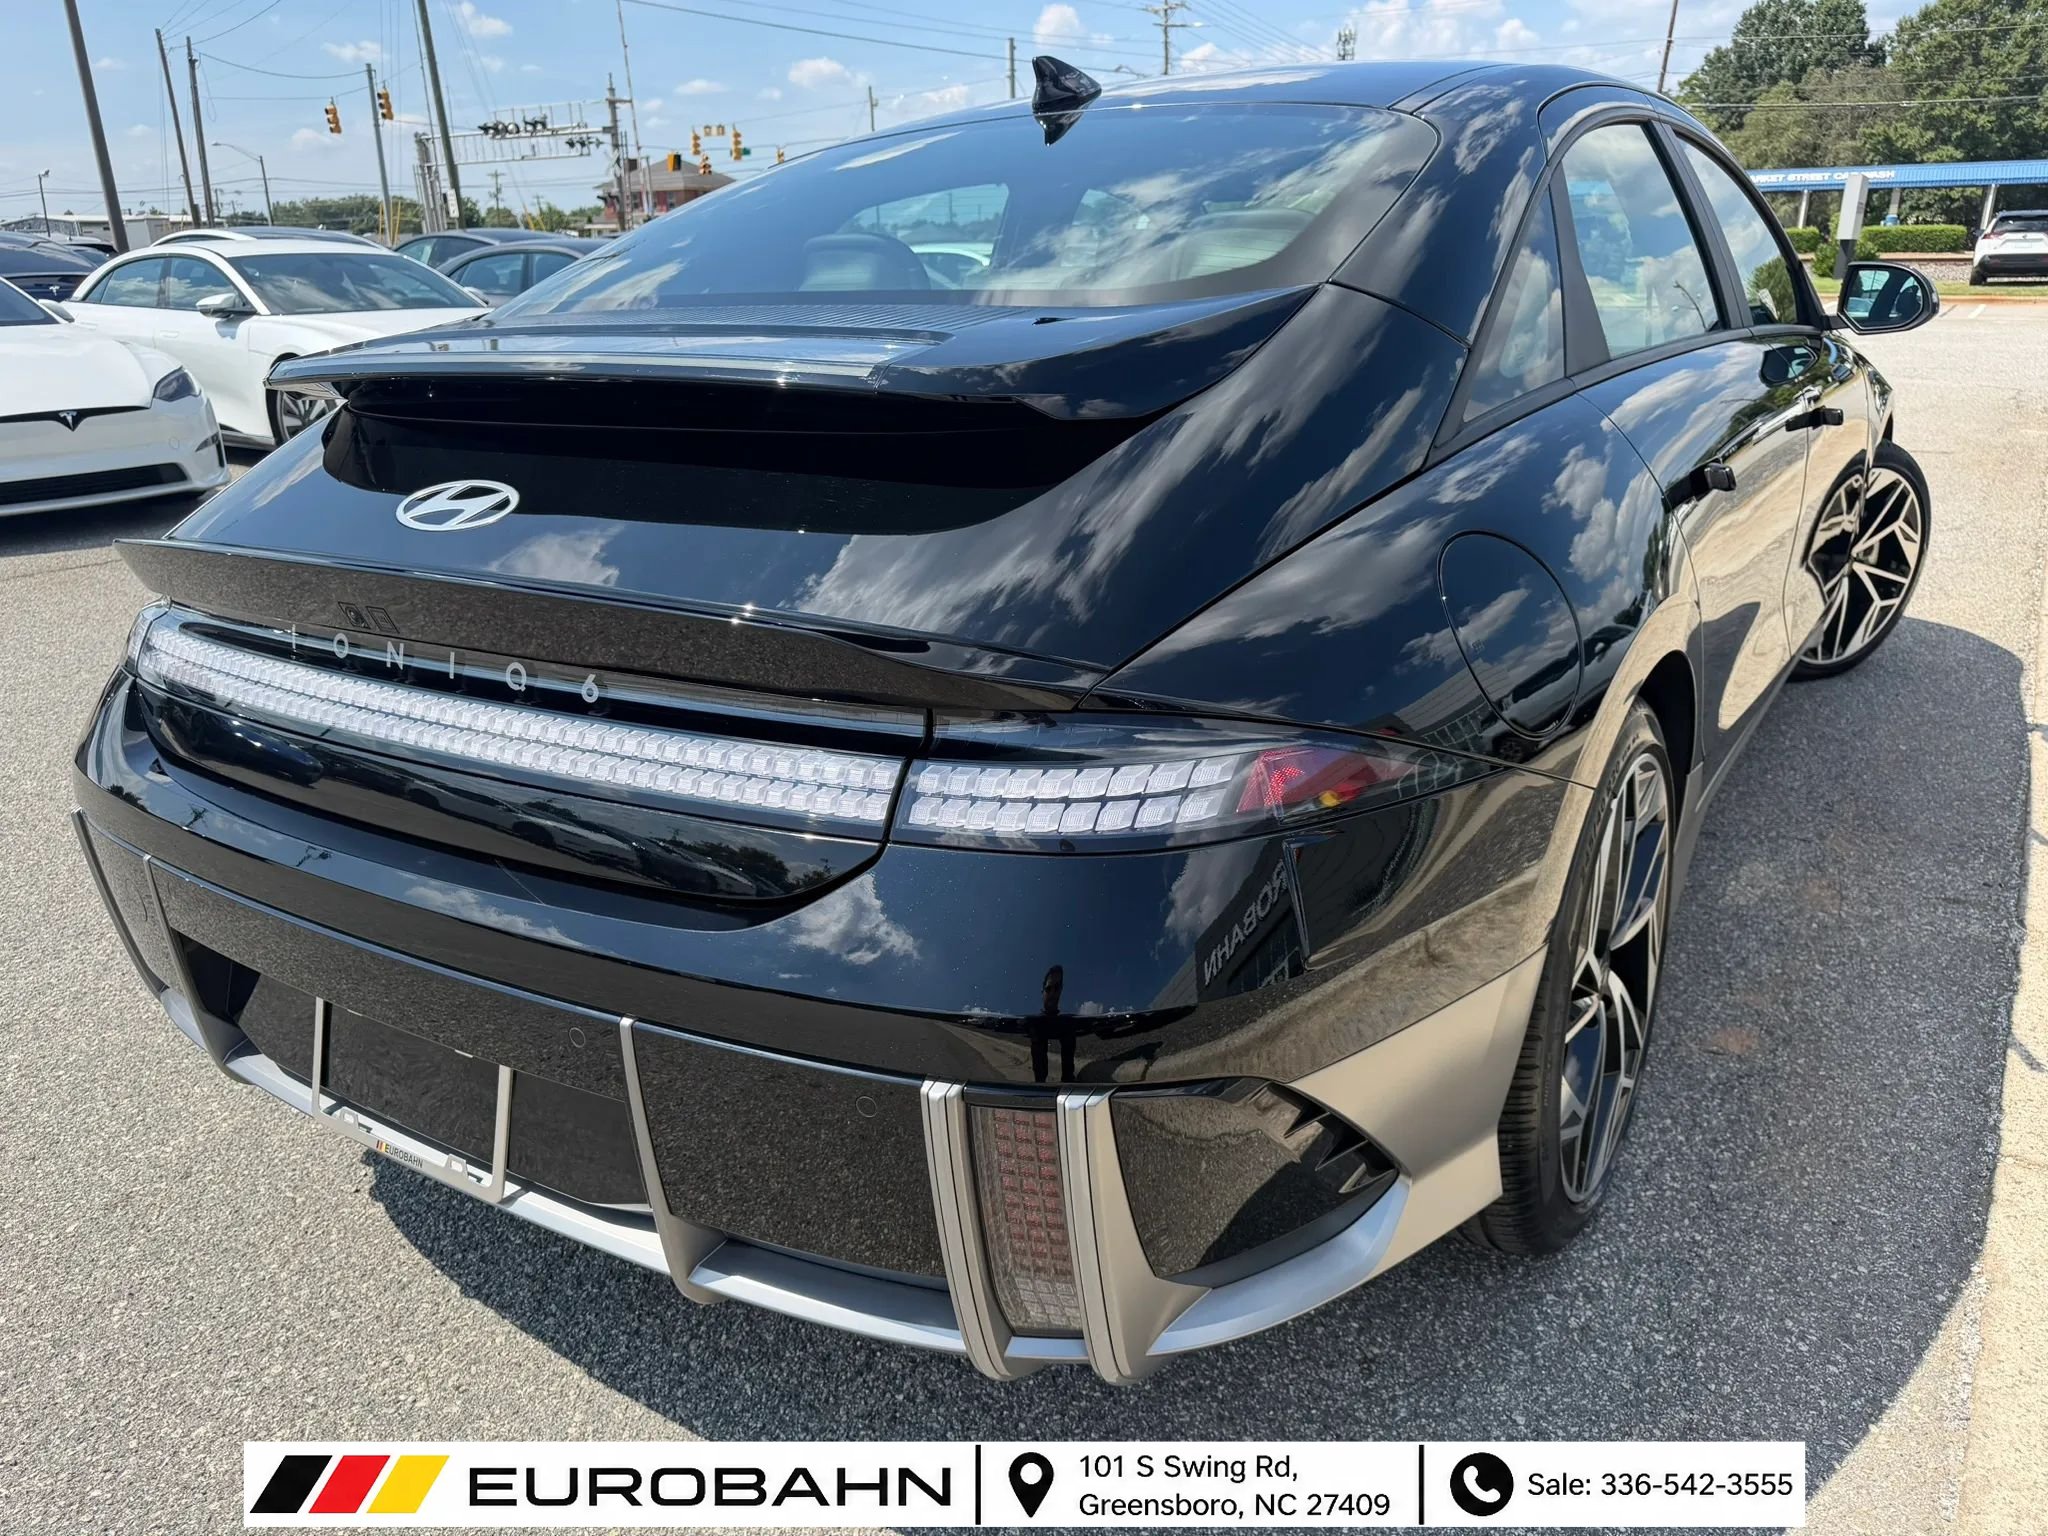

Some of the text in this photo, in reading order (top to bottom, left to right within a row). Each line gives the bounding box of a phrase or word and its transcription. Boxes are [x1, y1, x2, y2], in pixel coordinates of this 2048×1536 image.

[1750, 173, 1786, 184] ARKET
[1787, 172, 1832, 182] STREET
[291, 624, 600, 704] IONIQ 6
[384, 1142, 424, 1169] EUROBAHN
